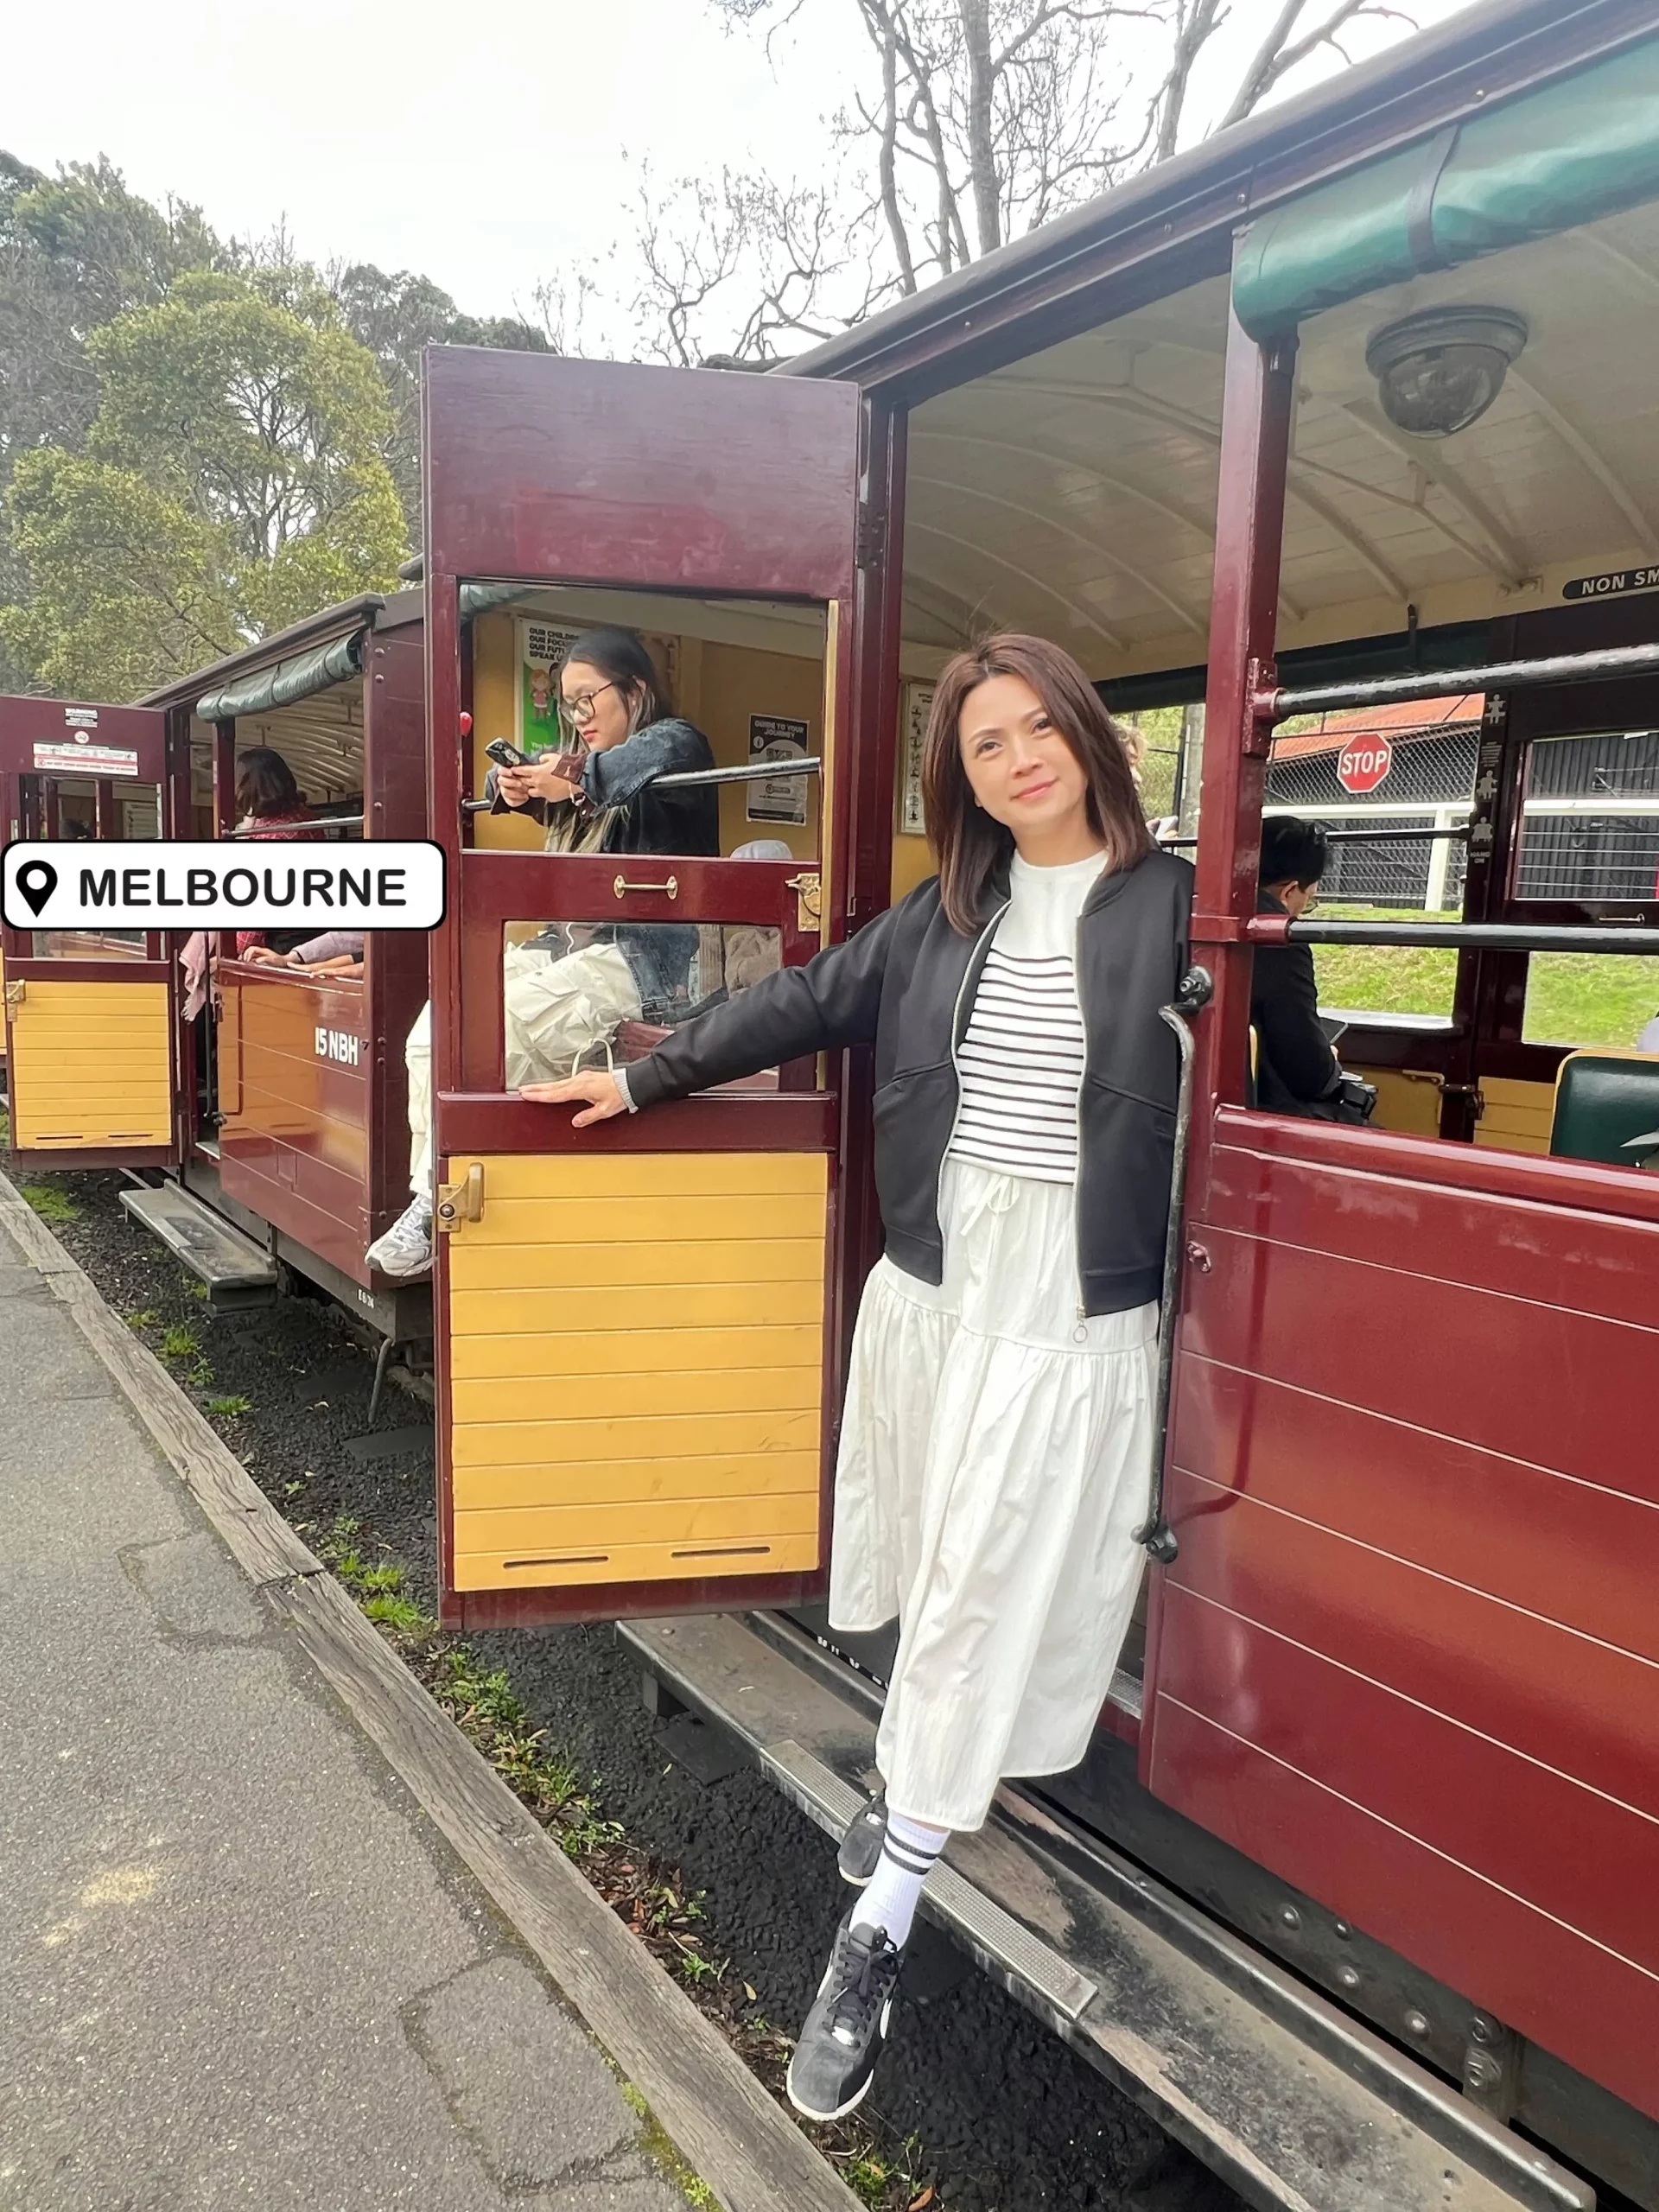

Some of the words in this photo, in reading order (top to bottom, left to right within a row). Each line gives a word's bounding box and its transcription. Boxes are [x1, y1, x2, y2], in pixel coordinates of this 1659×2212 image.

[1581, 575, 1624, 594] NON
[529, 627, 545, 636] OUR
[529, 635, 545, 644] OUR
[529, 643, 545, 652] OUR
[529, 651, 555, 661] SPEAK
[1341, 750, 1388, 776] STOP
[315, 1027, 327, 1056] 15
[328, 1030, 359, 1066] NBH
